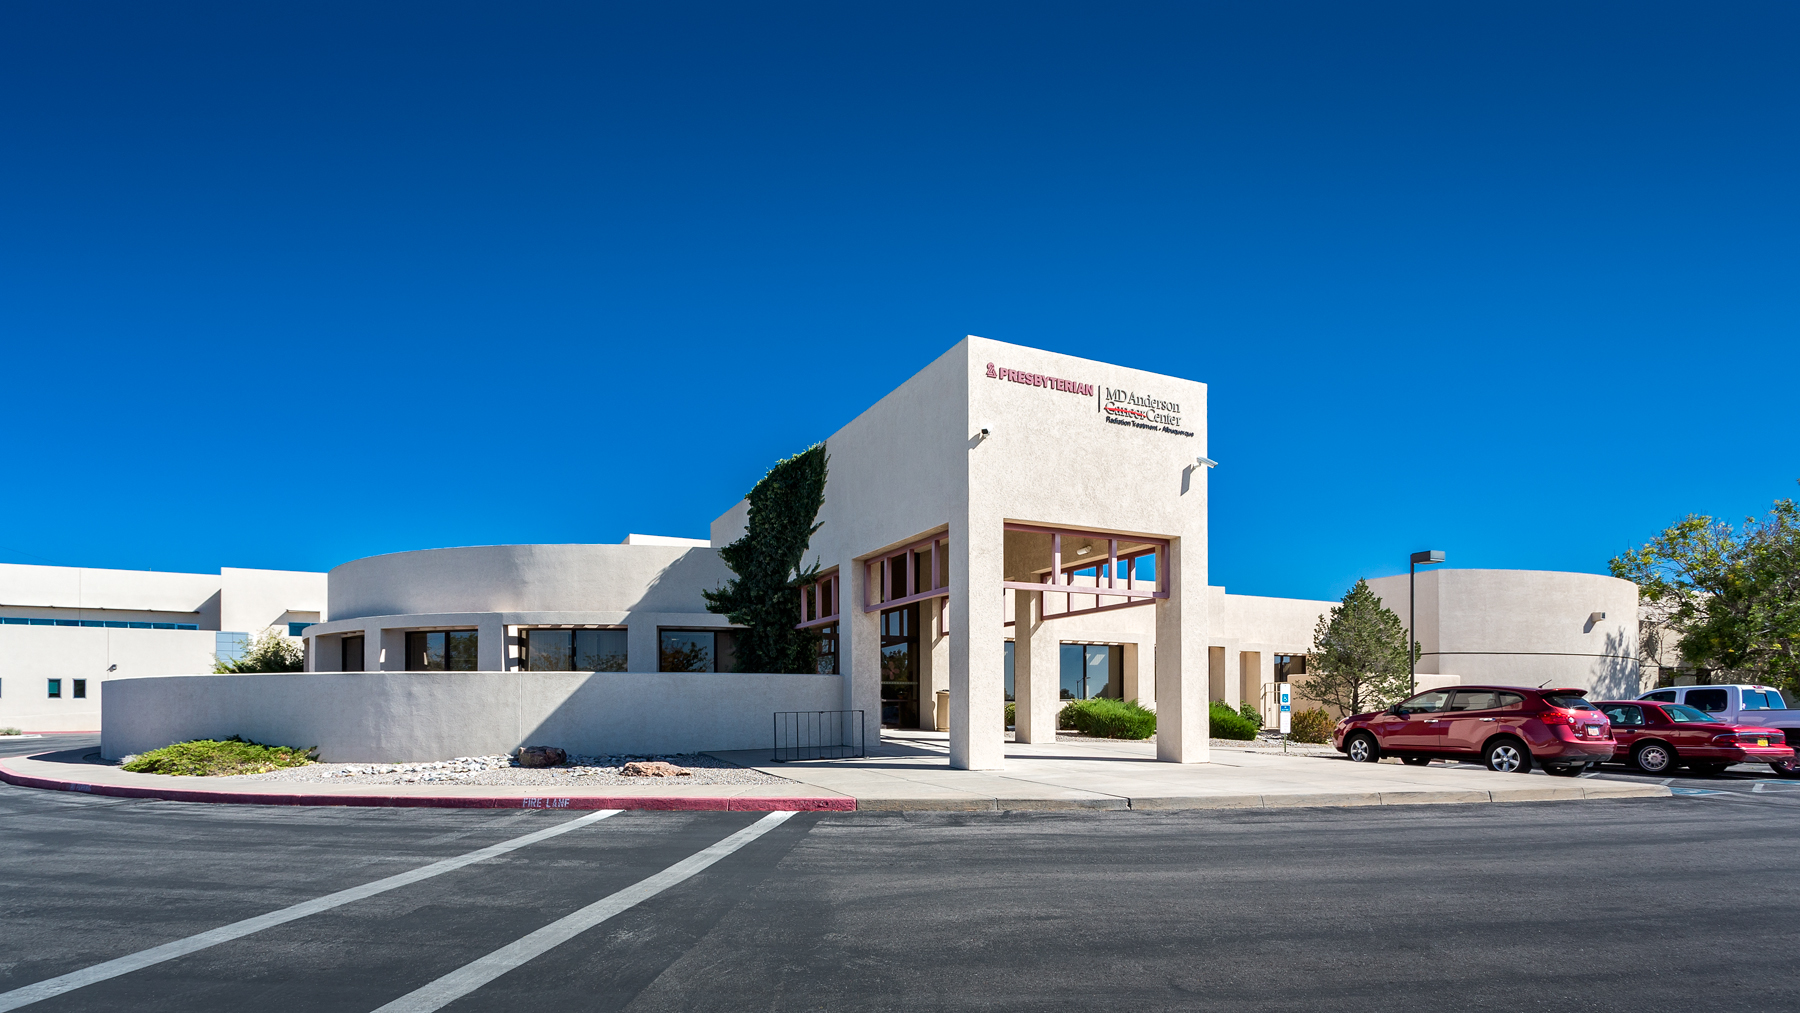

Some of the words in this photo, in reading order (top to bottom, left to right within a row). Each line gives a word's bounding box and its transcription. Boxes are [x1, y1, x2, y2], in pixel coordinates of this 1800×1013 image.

[998, 367, 1094, 397] PRESBYTERIAN
[1105, 387, 1127, 403] MD
[1127, 391, 1181, 414] Anderson
[1104, 401, 1146, 420] Cancer
[1146, 409, 1182, 427] Center
[1105, 416, 1131, 427] Radiation
[1131, 420, 1158, 431] Treatment
[1161, 426, 1195, 438] Albuquerque
[522, 797, 542, 808] FIRE
